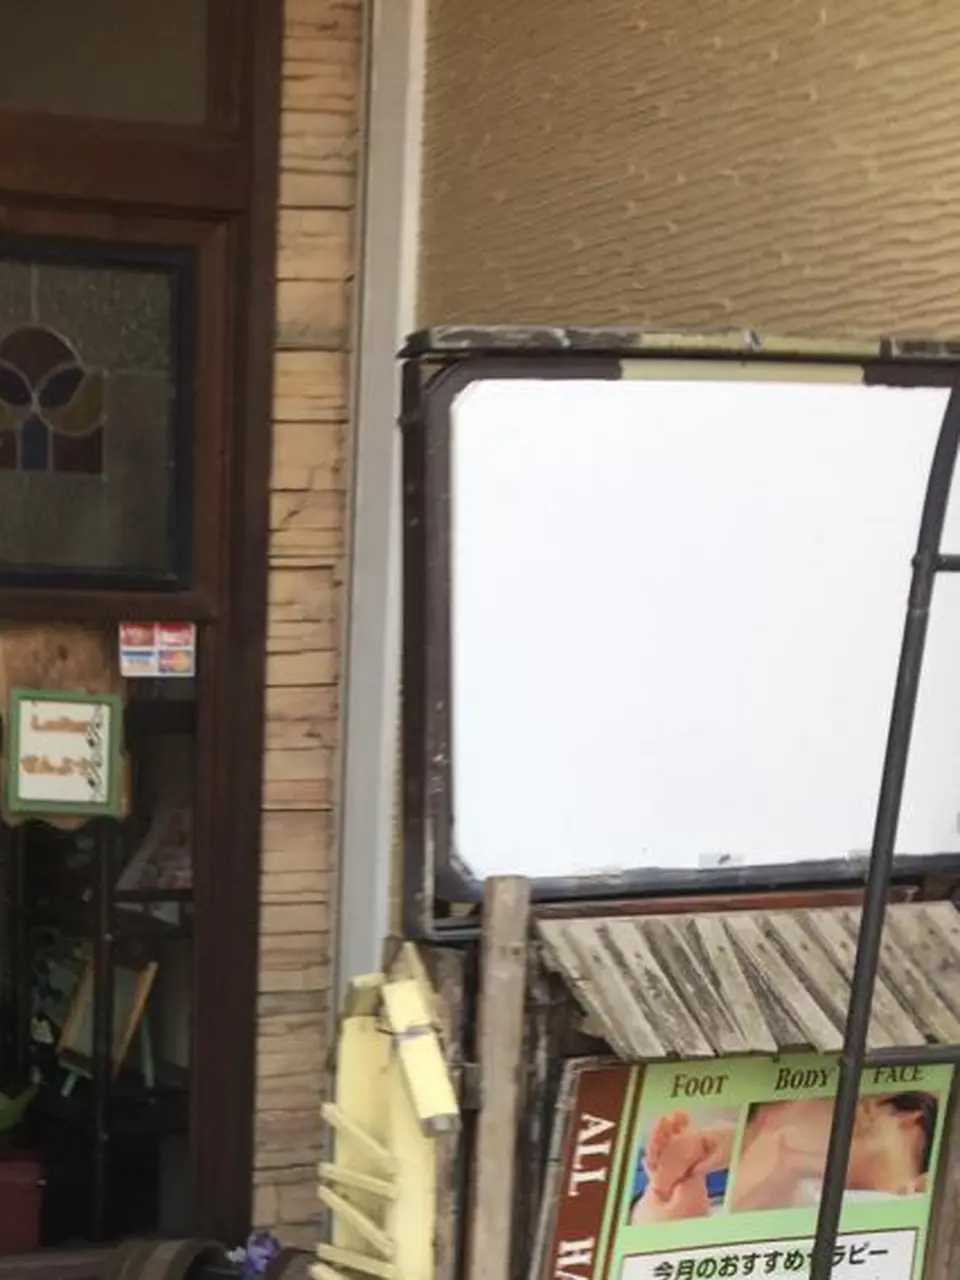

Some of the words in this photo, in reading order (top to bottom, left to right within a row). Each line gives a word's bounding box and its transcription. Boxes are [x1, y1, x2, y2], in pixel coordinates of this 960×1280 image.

[671, 1073, 729, 1099] FOOT
[773, 1067, 836, 1092] BODY
[871, 1063, 925, 1085] FACE
[568, 1113, 617, 1197] ALL
